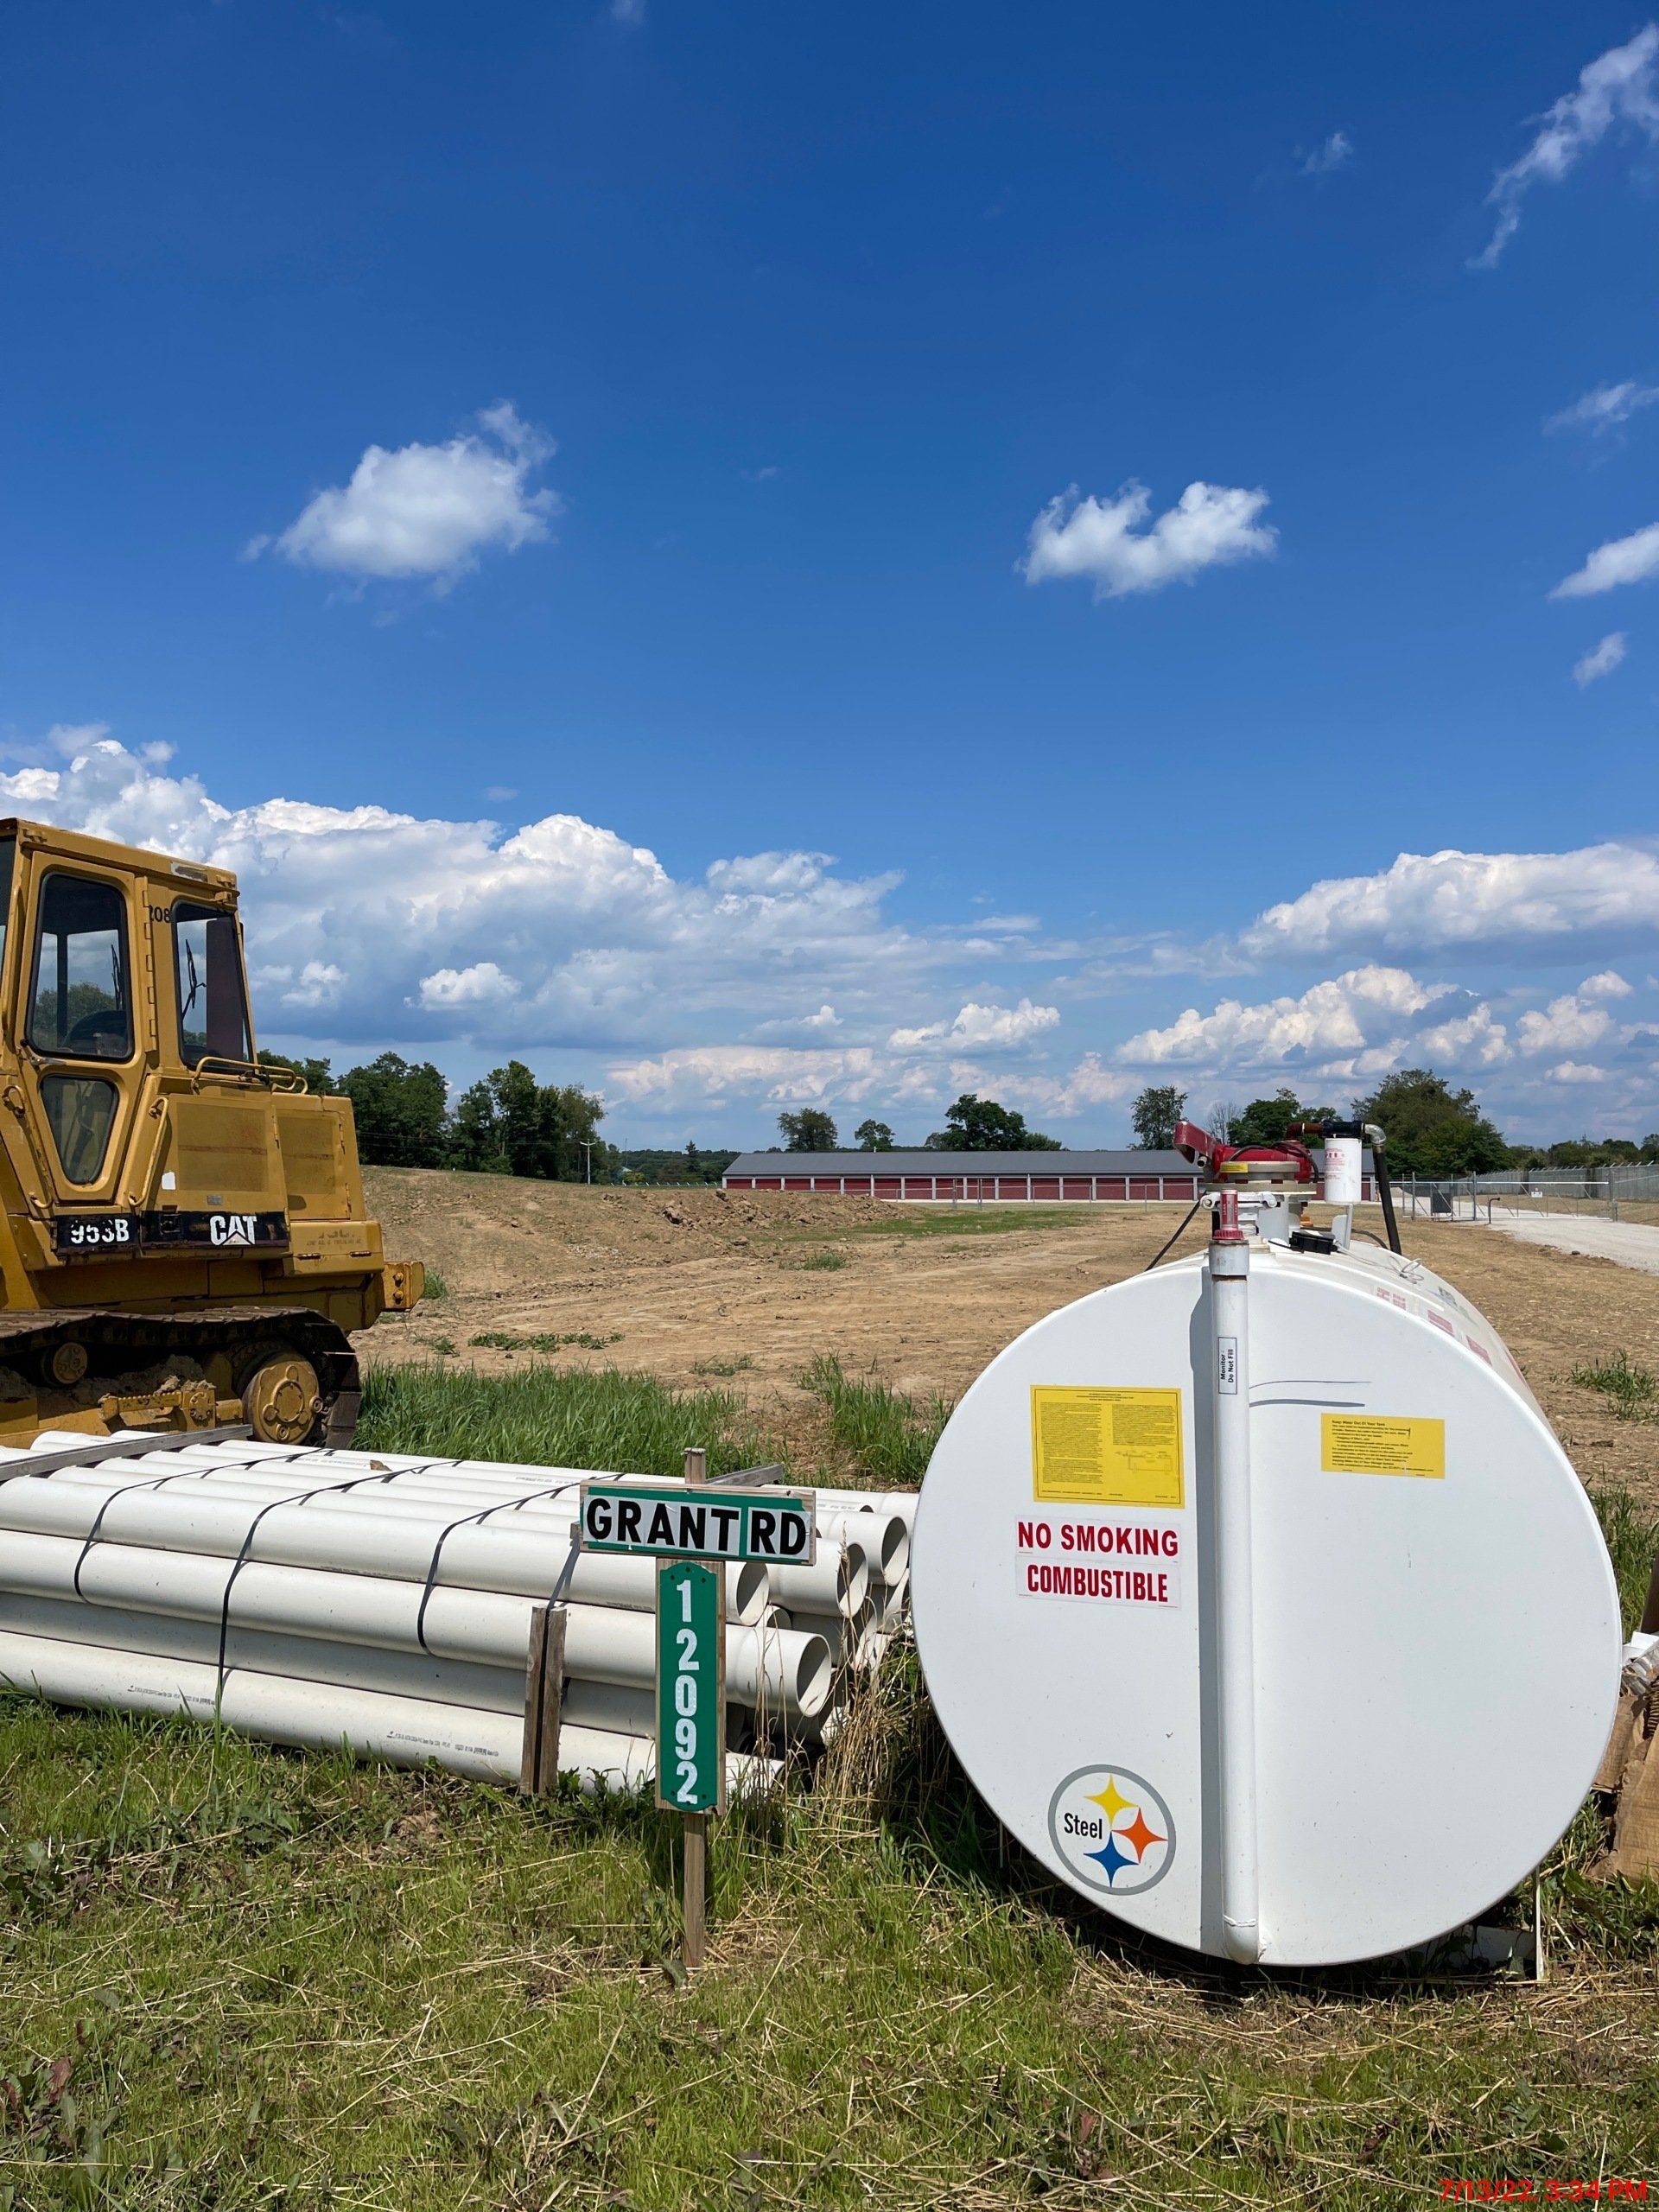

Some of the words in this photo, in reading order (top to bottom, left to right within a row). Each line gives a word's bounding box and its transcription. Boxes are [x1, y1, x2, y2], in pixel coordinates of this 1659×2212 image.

[210, 1215, 257, 1246] CAT
[1228, 1374, 1234, 1382] Do
[586, 1498, 740, 1552] GRANT
[751, 1510, 806, 1556] RD
[1018, 1522, 1052, 1549] NO
[1061, 1524, 1179, 1557] SMOKING
[1027, 1564, 1168, 1603] COMBUSTIBLE
[675, 1580, 700, 1805] 12092
[1064, 1813, 1103, 1840] Steel
